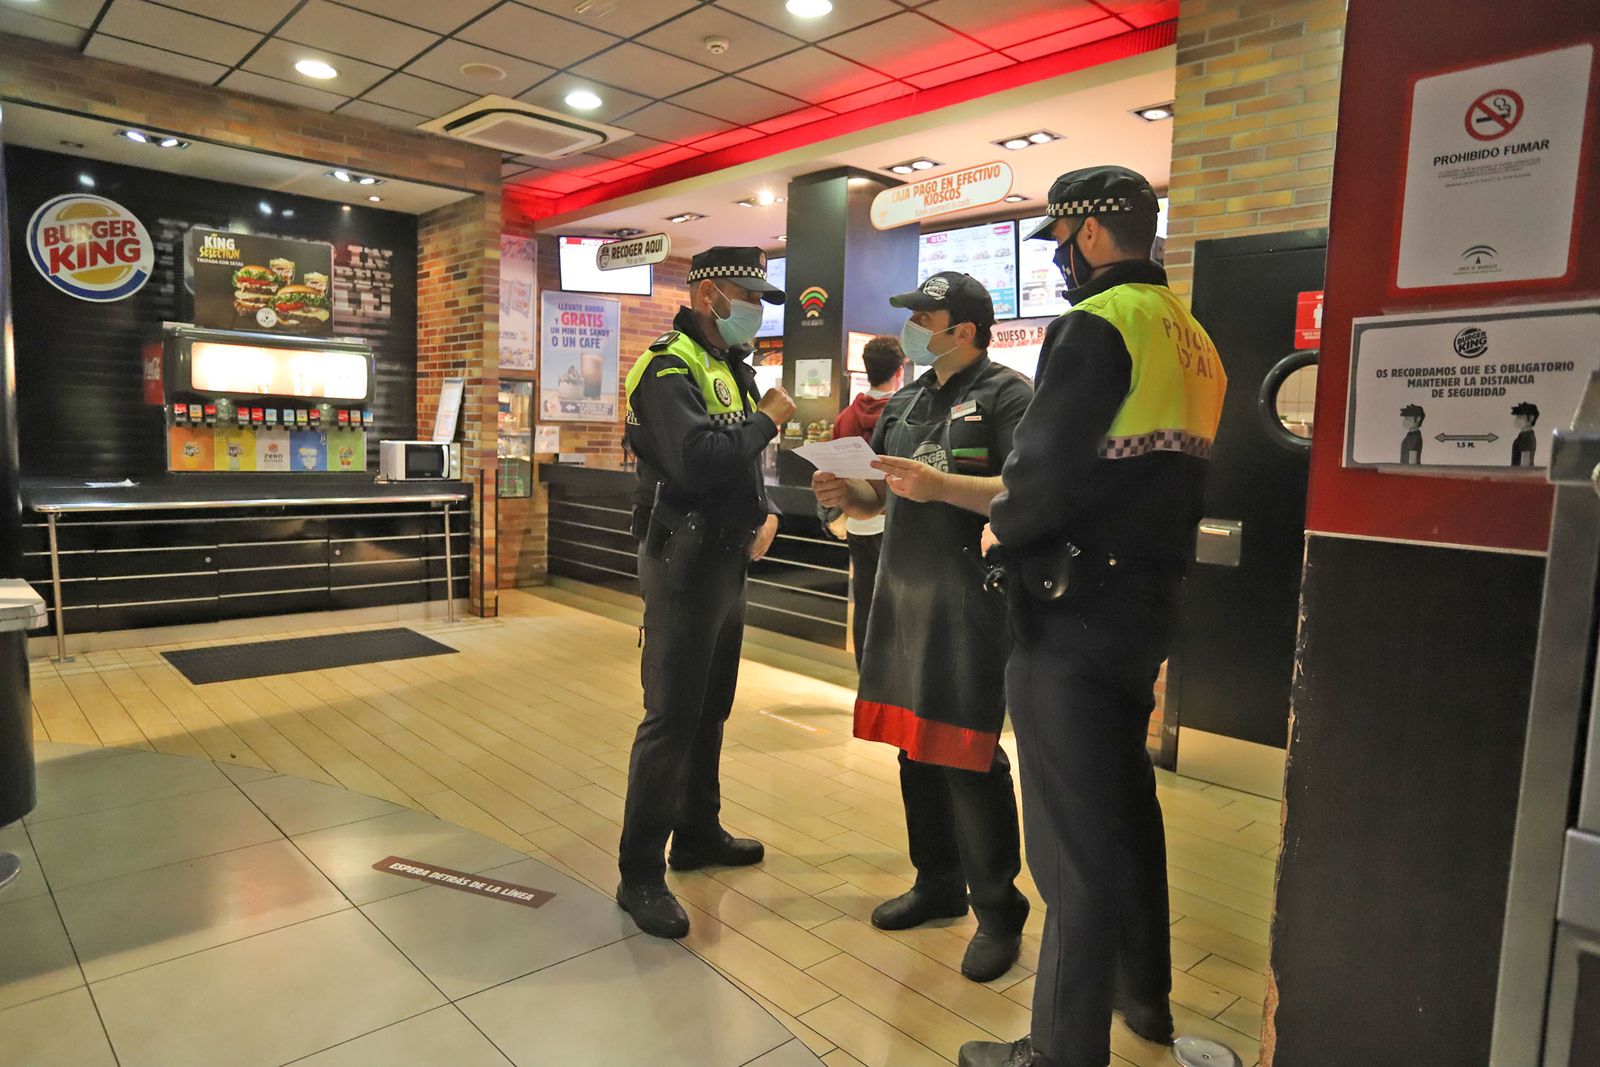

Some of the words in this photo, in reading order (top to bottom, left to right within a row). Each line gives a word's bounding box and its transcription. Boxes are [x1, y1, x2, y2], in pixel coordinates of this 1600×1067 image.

[1433, 148, 1500, 167] PROHIBIDO
[1503, 139, 1550, 156] FUMAR
[913, 180, 938, 198] PAGO
[941, 175, 954, 191] EN
[957, 165, 1001, 188] EFECTIVO
[923, 187, 961, 206] KIOSCOS
[43, 220, 137, 247] BURGER
[204, 235, 235, 250] KING
[49, 238, 141, 275] KING
[611, 244, 643, 260] RECOGER
[561, 311, 605, 328] GRATIS
[550, 327, 560, 335] UN
[561, 327, 577, 335] MINI
[579, 328, 588, 336] BK
[997, 329, 1026, 342] QUESO
[1457, 331, 1487, 345] BURGER
[552, 336, 558, 347] O
[562, 337, 576, 348] UN
[1458, 337, 1488, 353] KING
[1376, 368, 1388, 378] OS
[1391, 366, 1456, 378] RECORDAMOS
[1460, 365, 1480, 375] QUE
[1484, 364, 1497, 374] ES
[1500, 361, 1574, 374] OBLIGATORIO
[1407, 377, 1460, 388] MANTENER
[1464, 376, 1477, 386] LA
[1480, 374, 1535, 386] DISTANCIA
[1431, 388, 1444, 398] DE
[1447, 387, 1506, 398] SEGURIDAD
[913, 450, 947, 464] URGER
[388, 862, 430, 877] ESPERA
[428, 872, 472, 888] DETRÁS
[468, 881, 487, 891] DE
[484, 885, 504, 894] LA
[500, 888, 535, 902] LÍNEA
